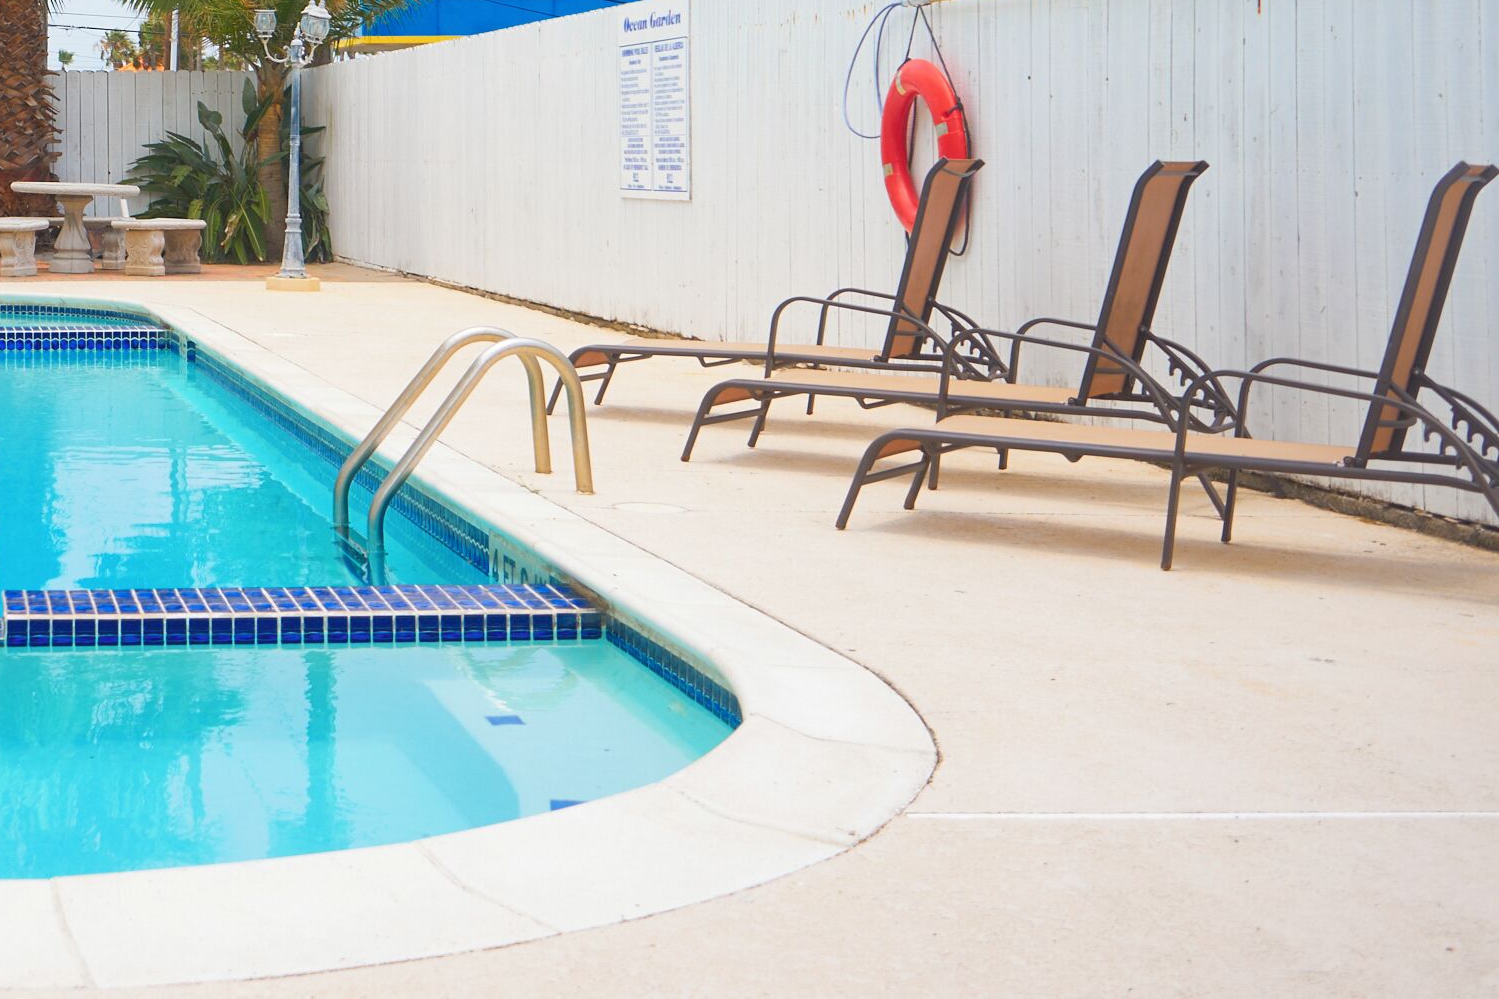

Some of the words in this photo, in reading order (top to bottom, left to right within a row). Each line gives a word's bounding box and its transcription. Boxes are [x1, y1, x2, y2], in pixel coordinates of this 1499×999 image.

[624, 17, 647, 32] Ocean
[650, 9, 681, 29] Garden
[492, 548, 499, 583] 4
